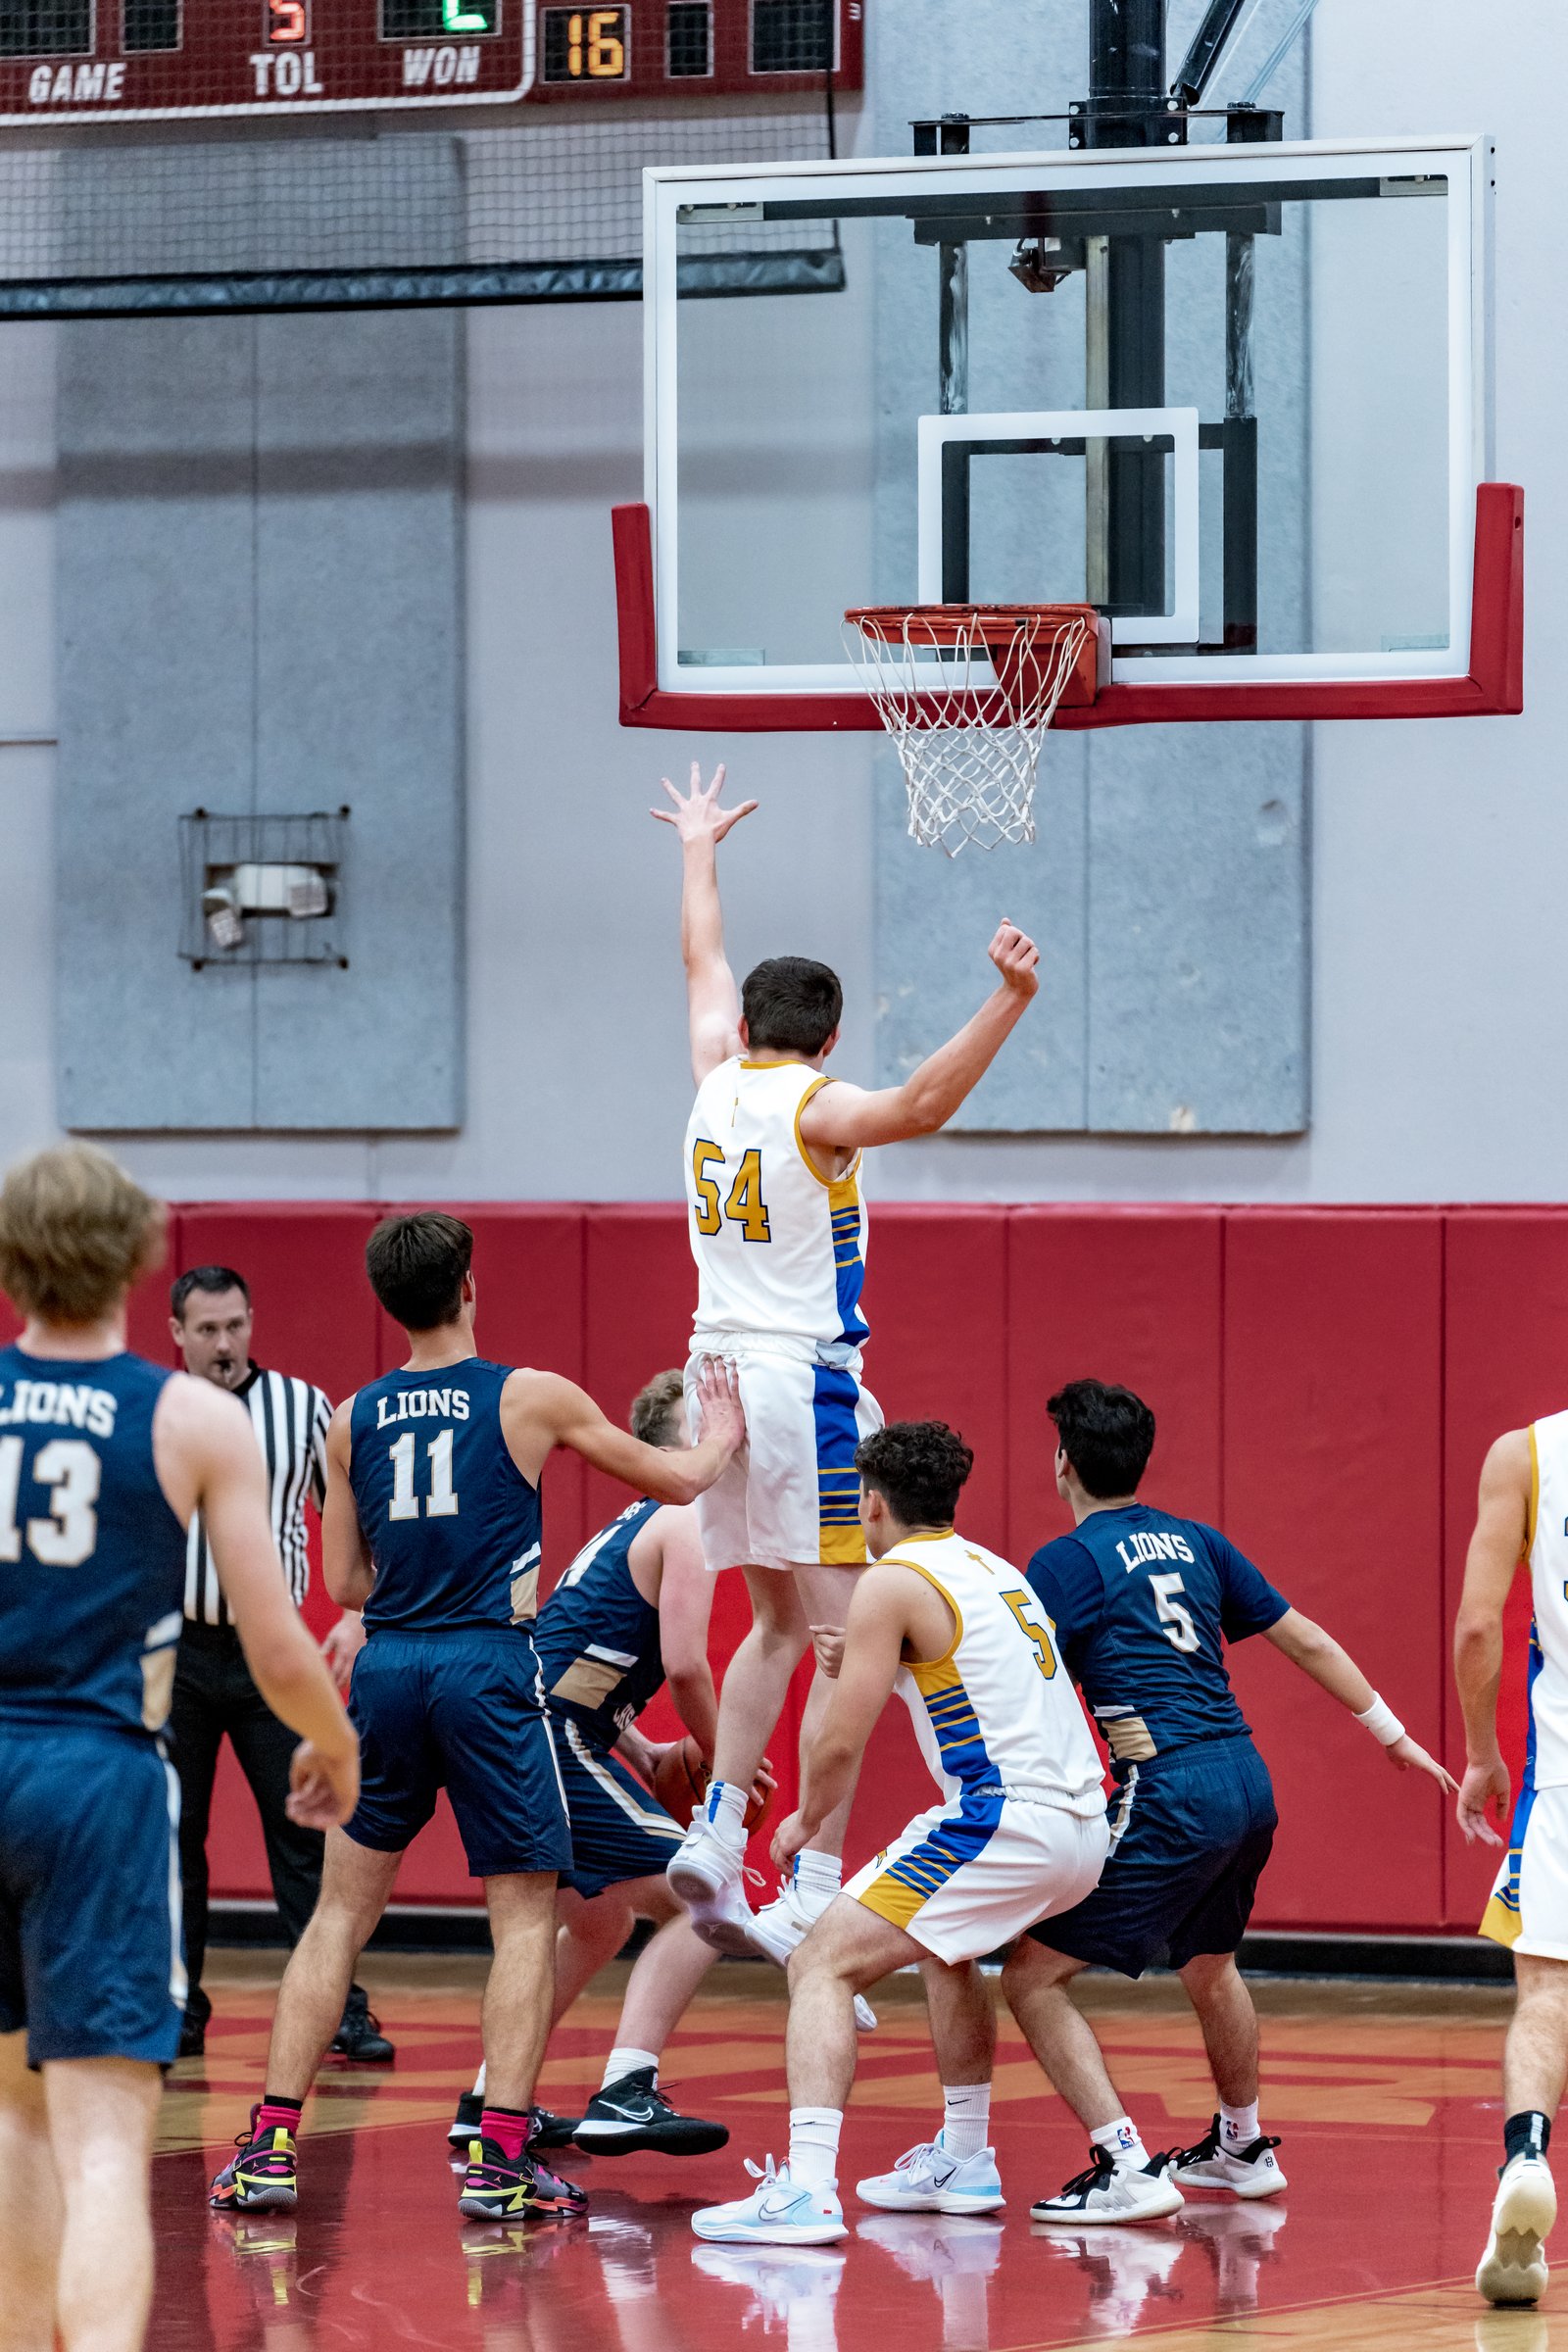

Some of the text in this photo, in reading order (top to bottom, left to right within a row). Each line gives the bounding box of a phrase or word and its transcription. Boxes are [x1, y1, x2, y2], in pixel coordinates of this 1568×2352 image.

[250, 51, 324, 96] TOL
[403, 46, 481, 86] WON
[567, 12, 624, 76] 16
[29, 63, 127, 104] GAME
[693, 1138, 771, 1243] 54
[377, 1389, 469, 1430] LIONS
[0, 1435, 102, 1566] 13
[389, 1429, 458, 1521] 11
[1115, 1532, 1195, 1574] LIONS
[999, 1589, 1057, 1680] 5
[1148, 1572, 1201, 1653] 5
